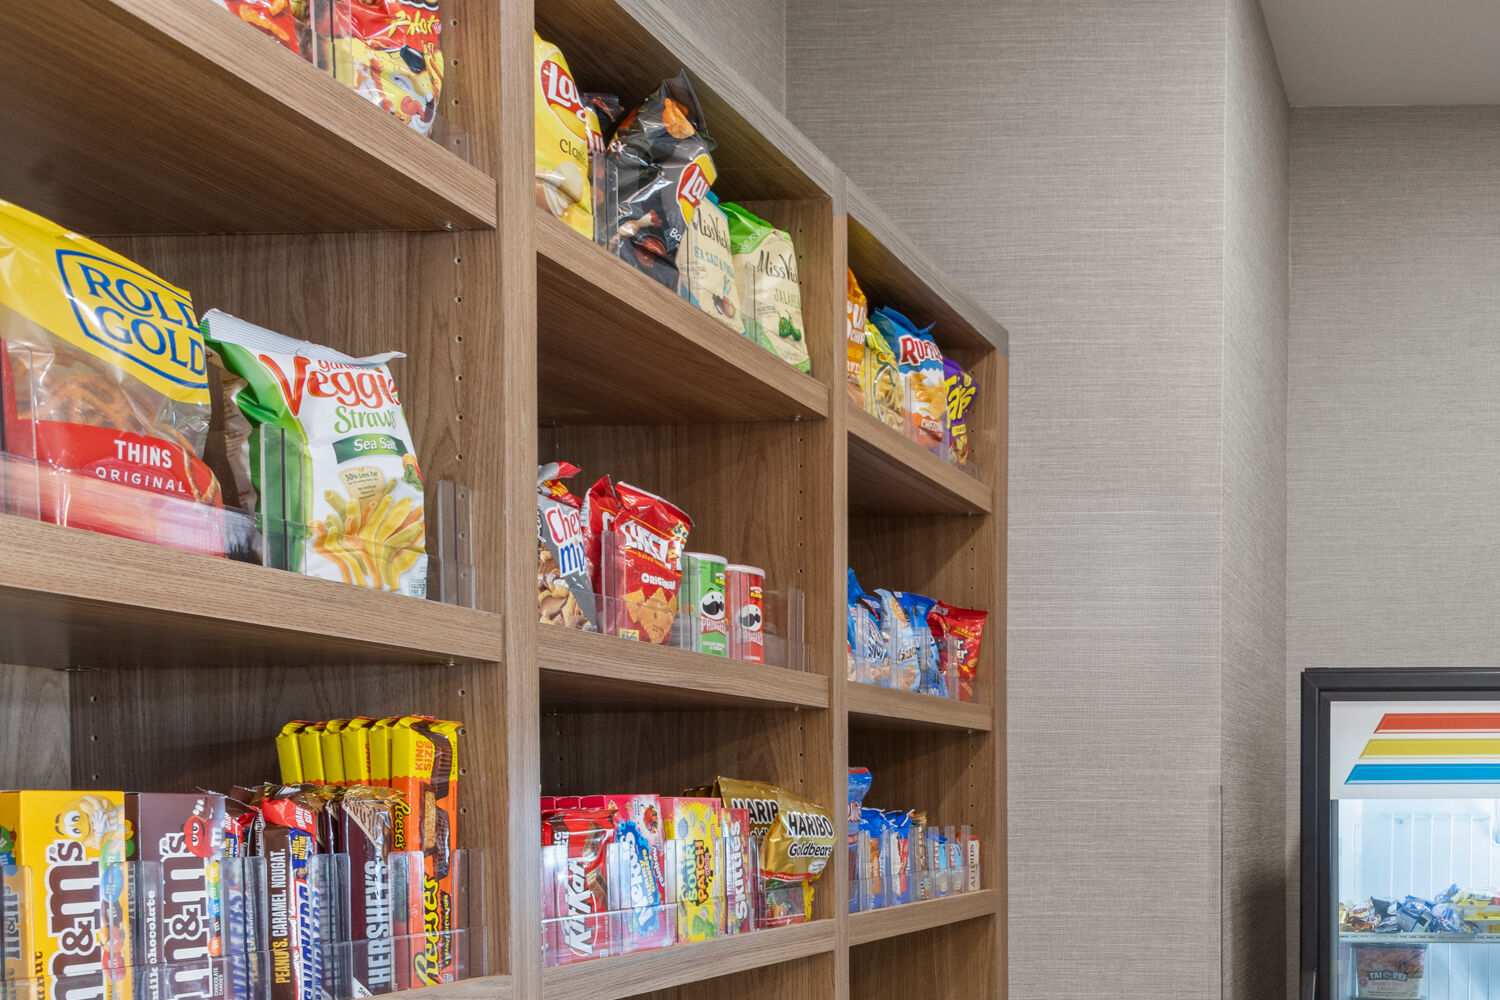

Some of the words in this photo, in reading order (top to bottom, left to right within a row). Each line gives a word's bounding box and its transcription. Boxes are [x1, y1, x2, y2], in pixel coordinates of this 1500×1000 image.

[76, 261, 200, 332] ROLD
[94, 306, 206, 376] GOLD
[334, 405, 396, 433] Straws
[114, 440, 172, 469] THINS
[354, 438, 377, 452] Sea
[95, 466, 186, 493] ORIGINAL
[415, 740, 424, 771] KING
[424, 741, 434, 772] SIZE
[787, 812, 834, 838] HARIBO
[270, 848, 287, 889] NOUGAT.
[788, 843, 832, 858] Goldbears
[685, 842, 698, 901] SOUR
[695, 839, 708, 905] PATCH
[147, 890, 157, 966] chocolate
[271, 889, 288, 938] CARAMEL.
[364, 860, 391, 986] HERSHEY'S
[273, 937, 291, 984] PEANUTS.
[1369, 971, 1383, 980] TAI
[1393, 972, 1407, 981] PEI
